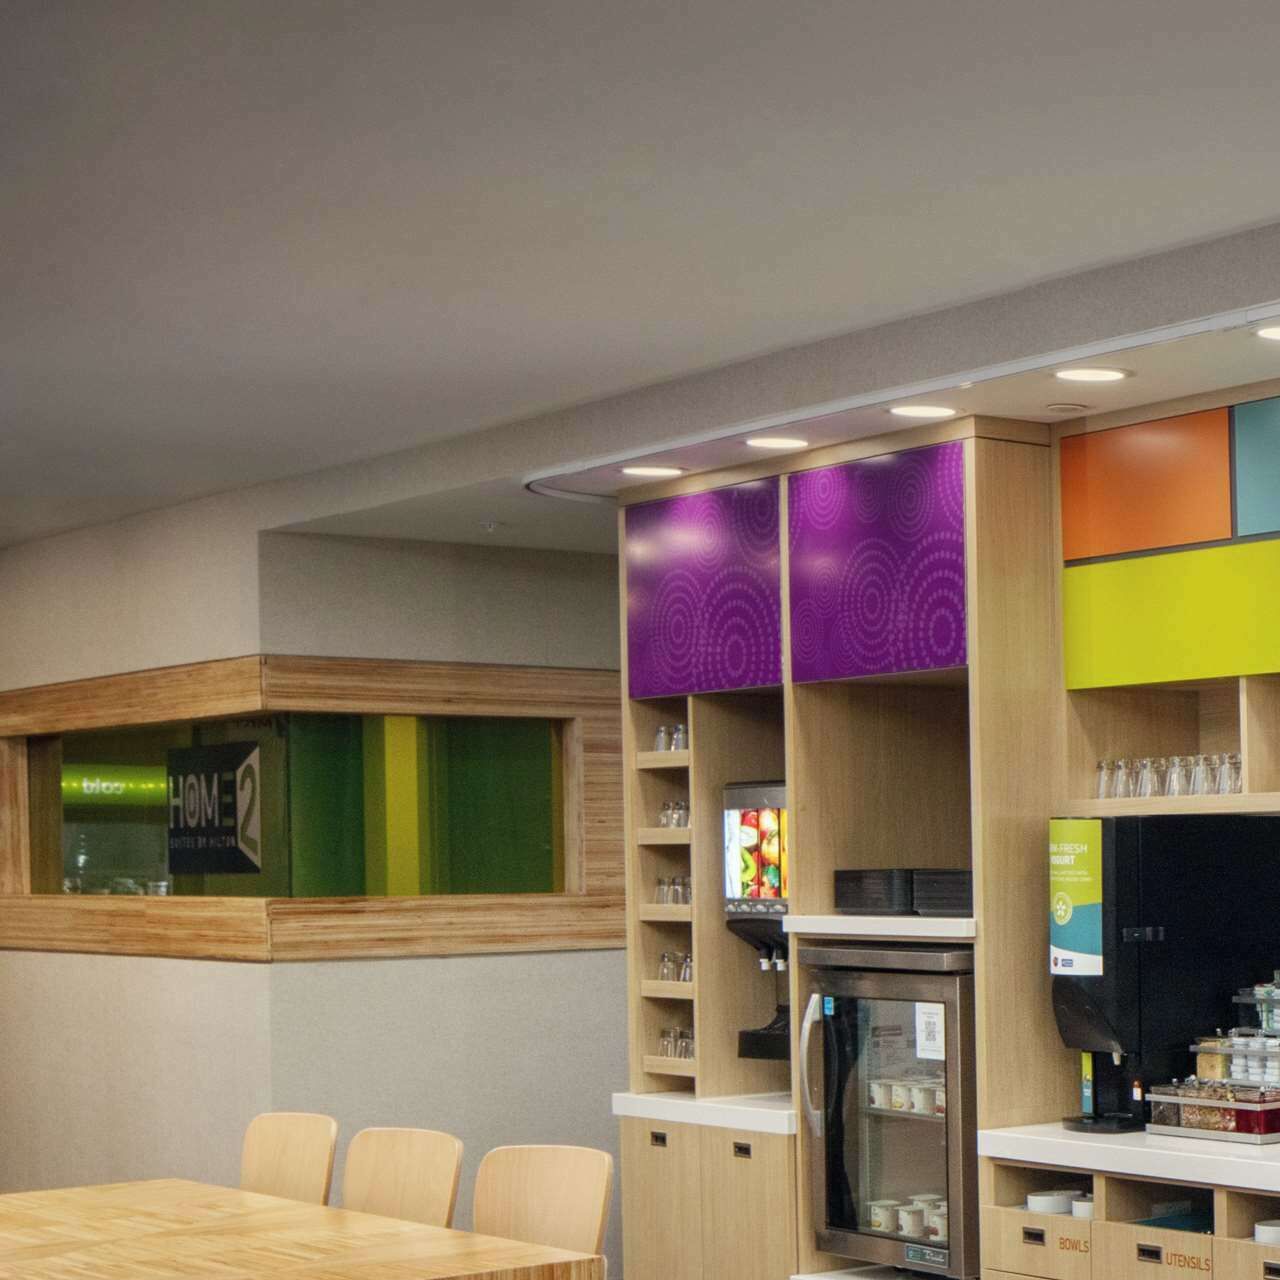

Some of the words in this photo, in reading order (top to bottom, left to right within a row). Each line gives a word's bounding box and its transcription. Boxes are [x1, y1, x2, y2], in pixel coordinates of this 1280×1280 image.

[1049, 855, 1076, 865] OGURT
[1059, 1236, 1090, 1253] BOWLS
[1165, 1252, 1211, 1272] UTENSILS
